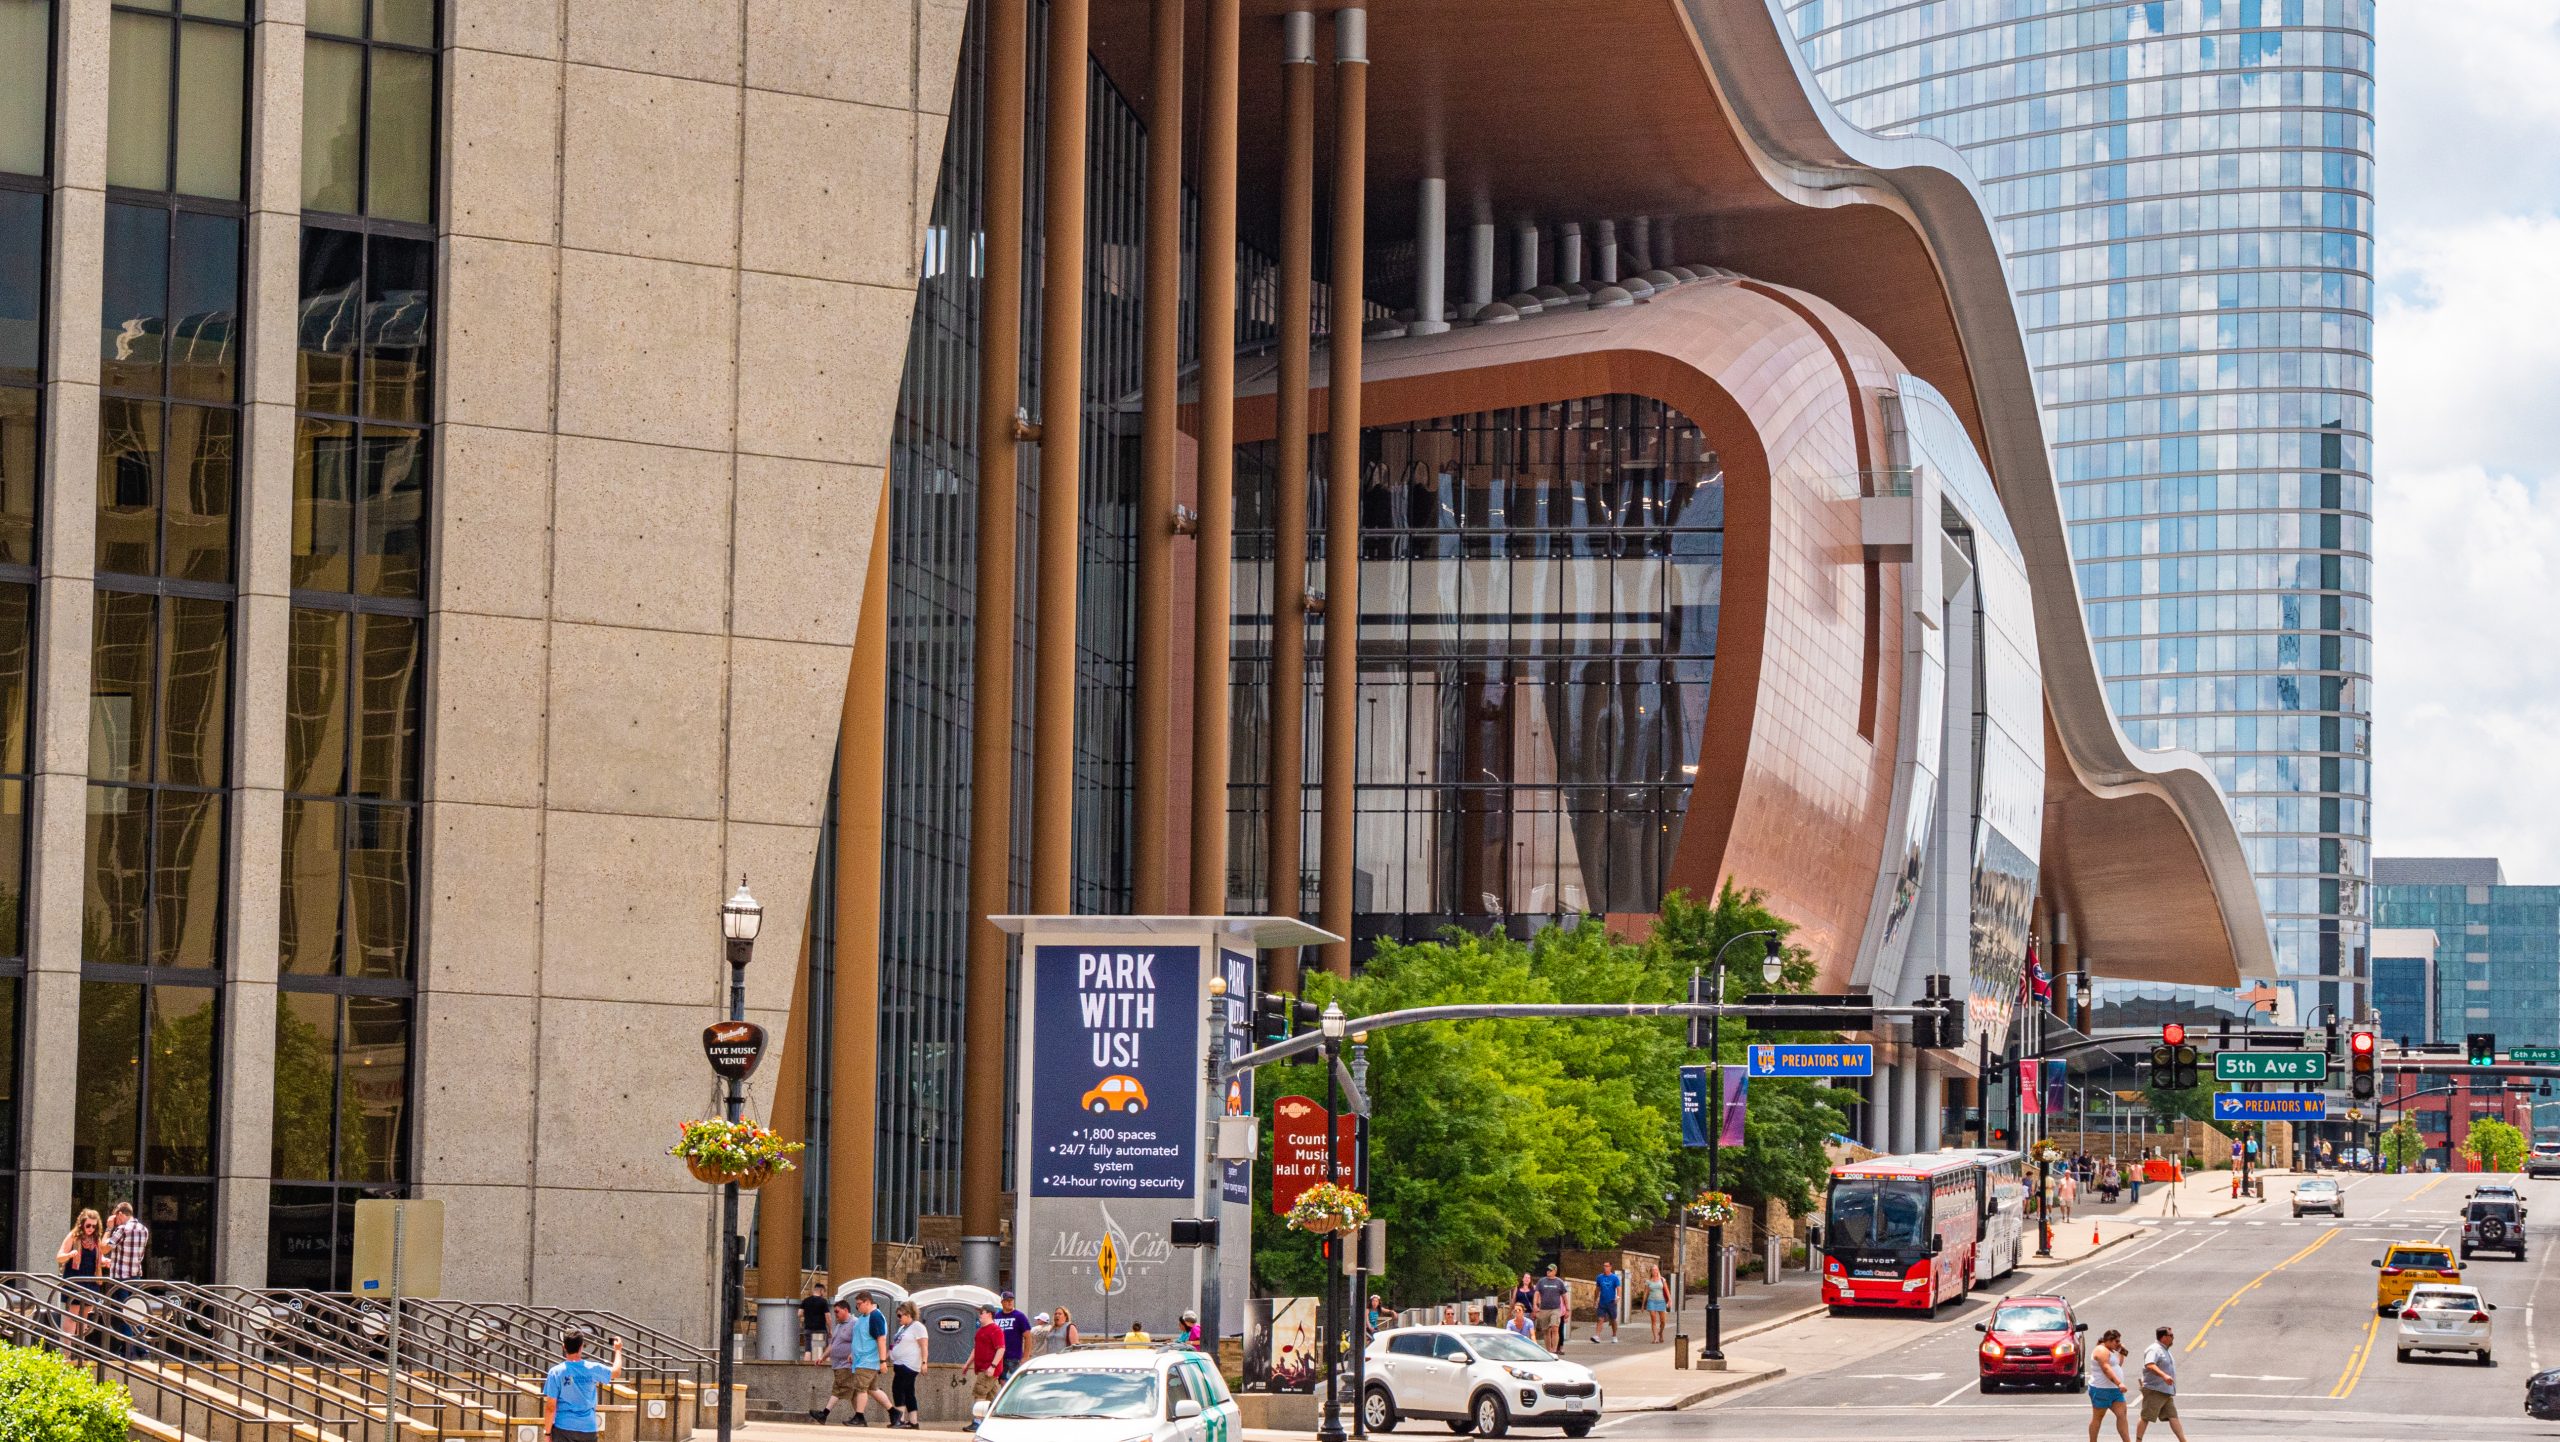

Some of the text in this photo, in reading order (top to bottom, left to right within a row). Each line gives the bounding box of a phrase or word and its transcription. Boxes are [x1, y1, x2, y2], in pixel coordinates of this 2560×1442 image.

[1078, 953, 1156, 989] PARK
[1228, 958, 1246, 998] PARK
[1079, 993, 1155, 1029] WITH
[709, 1047, 757, 1055] LIVE MUSIC
[1093, 1032, 1140, 1068] US!
[720, 1057, 747, 1065] VENUE
[1757, 1056, 1775, 1066] US
[1782, 1054, 1864, 1067] PREDATORS WAY
[2226, 1059, 2317, 1073] 5th Ave S
[2245, 1100, 2326, 1113] PREDATORS WAY
[1083, 1128, 1157, 1142] 1,800 spaces
[1059, 1143, 1179, 1158] 24/7 fully automated
[1093, 1162, 1134, 1174] system
[1276, 1163, 1300, 1176] Hall
[1304, 1163, 1316, 1176] of
[1052, 1174, 1185, 1190] 24-hour roving security
[1129, 1231, 1175, 1264] City
[1072, 1266, 1147, 1275] CETER
